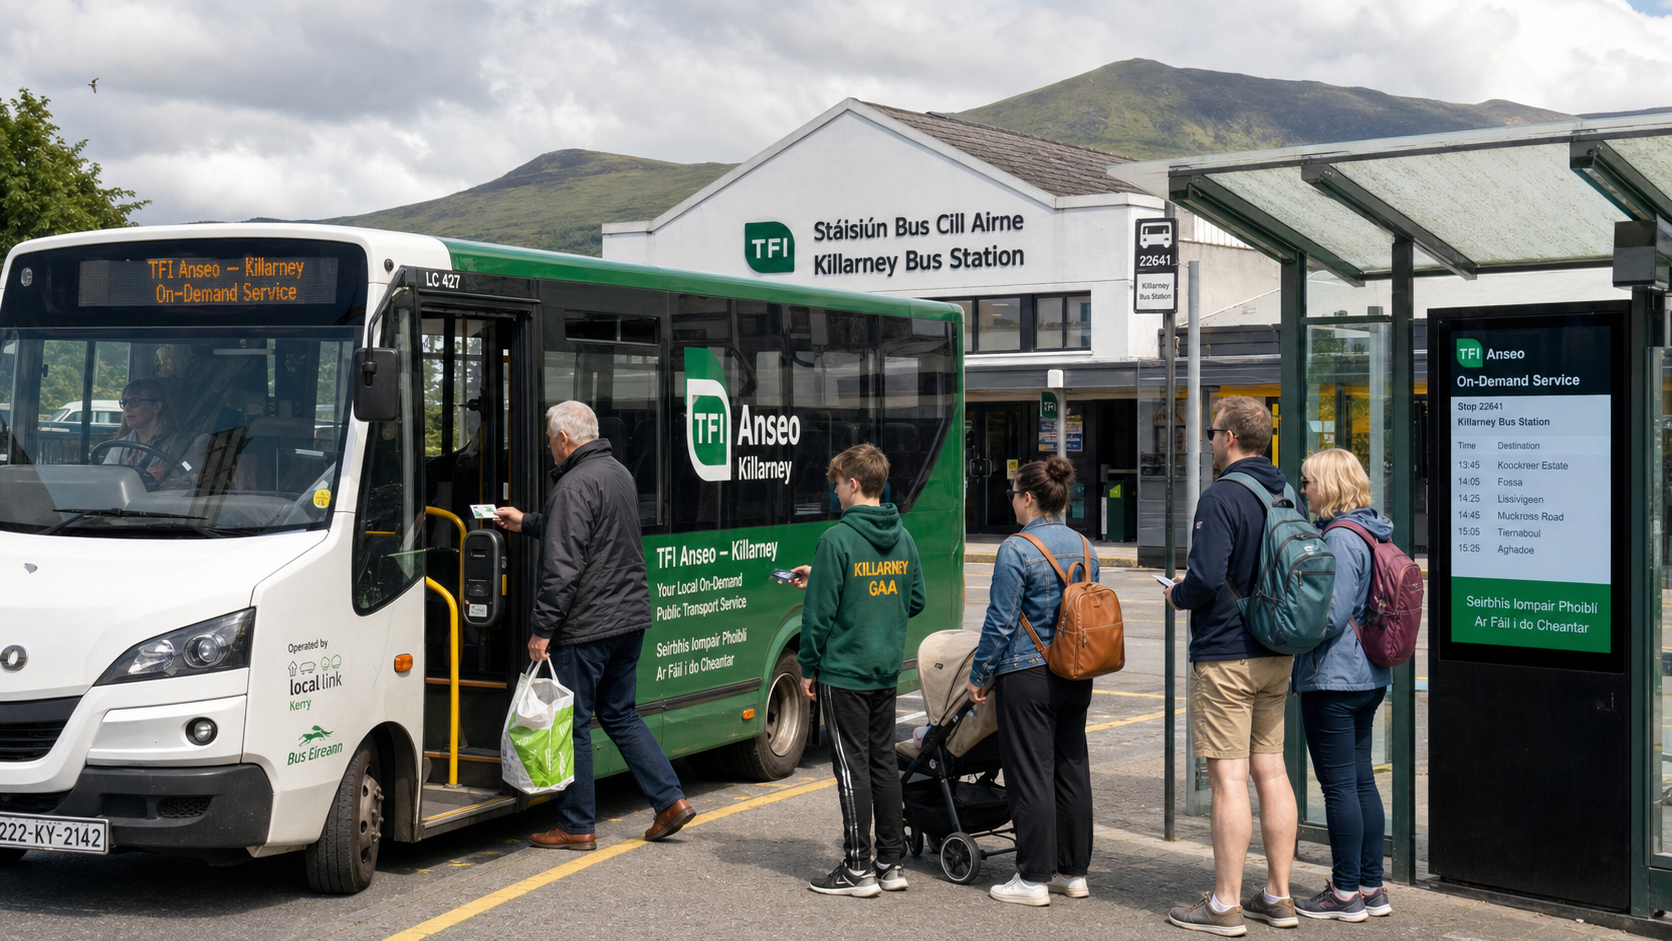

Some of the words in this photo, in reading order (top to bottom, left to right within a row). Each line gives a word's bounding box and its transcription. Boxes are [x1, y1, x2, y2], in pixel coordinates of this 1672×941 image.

[814, 218, 887, 241] Stáisiún
[895, 216, 930, 237] Bus
[936, 213, 965, 234] Cill
[971, 211, 1024, 232] Airne
[752, 237, 788, 259] TFI
[147, 260, 174, 279] TFI
[178, 260, 220, 279] Anseo
[244, 257, 304, 280] Killarney
[814, 253, 898, 277] Killarney
[905, 250, 942, 271] Bus
[949, 245, 1024, 269] Station
[1139, 254, 1170, 267] 22641
[426, 272, 439, 287] LC
[443, 273, 461, 289] 427
[156, 283, 238, 303] On-Demand
[243, 282, 297, 301] Service
[1459, 348, 1480, 360] TFI
[1486, 348, 1525, 360] Anseo
[1456, 375, 1529, 387] On-Demand
[1532, 374, 1581, 386] Service
[1457, 403, 1477, 412] Stop
[1479, 403, 1503, 411] 22641
[694, 413, 723, 444] TFI
[737, 404, 801, 446] Anseo
[1457, 417, 1496, 428] Killarney
[1499, 418, 1516, 426] Bus
[1518, 418, 1550, 426] Station
[1458, 442, 1476, 450] Time
[1497, 442, 1540, 450] Destination
[738, 456, 792, 485] Killarney
[1458, 461, 1480, 469] 13:45
[1541, 461, 1568, 470] Estate
[1458, 478, 1480, 486] 14:05
[1497, 478, 1523, 487] Fossa
[1497, 494, 1544, 505] Lissivigeen
[1458, 511, 1480, 519] 14:45
[1541, 512, 1564, 521] Road
[1458, 527, 1480, 536] 15:05
[1497, 528, 1541, 538] Tiernaboul
[656, 546, 676, 569] TFI
[680, 545, 716, 567] Anseo
[731, 539, 778, 562] Killarney
[1497, 545, 1535, 555] Aghadoe
[854, 560, 909, 577] KILLARNEY
[657, 583, 675, 598] Your
[677, 579, 698, 595] Local
[699, 573, 743, 591] On-Demand
[869, 580, 898, 596] GAA
[656, 604, 681, 621] Public
[682, 599, 719, 617] Transport
[720, 595, 747, 611] Service
[1513, 598, 1555, 613] Iompair
[1558, 601, 1598, 614] Phoiblí
[1475, 616, 1488, 626] Ar
[1490, 616, 1510, 628] Fáil
[1519, 618, 1534, 629] do
[1537, 619, 1590, 634] Cheantar
[288, 640, 319, 654] Operated
[320, 639, 329, 649] by
[691, 633, 720, 652] Iompair
[656, 666, 667, 681] Ar
[689, 659, 700, 674] do
[700, 655, 735, 672] Cheantar
[290, 675, 320, 695] local
[322, 671, 342, 689] link
[290, 700, 312, 711] Kerry
[287, 752, 307, 766] Bus
[0, 822, 101, 847] 222-KY-2142
